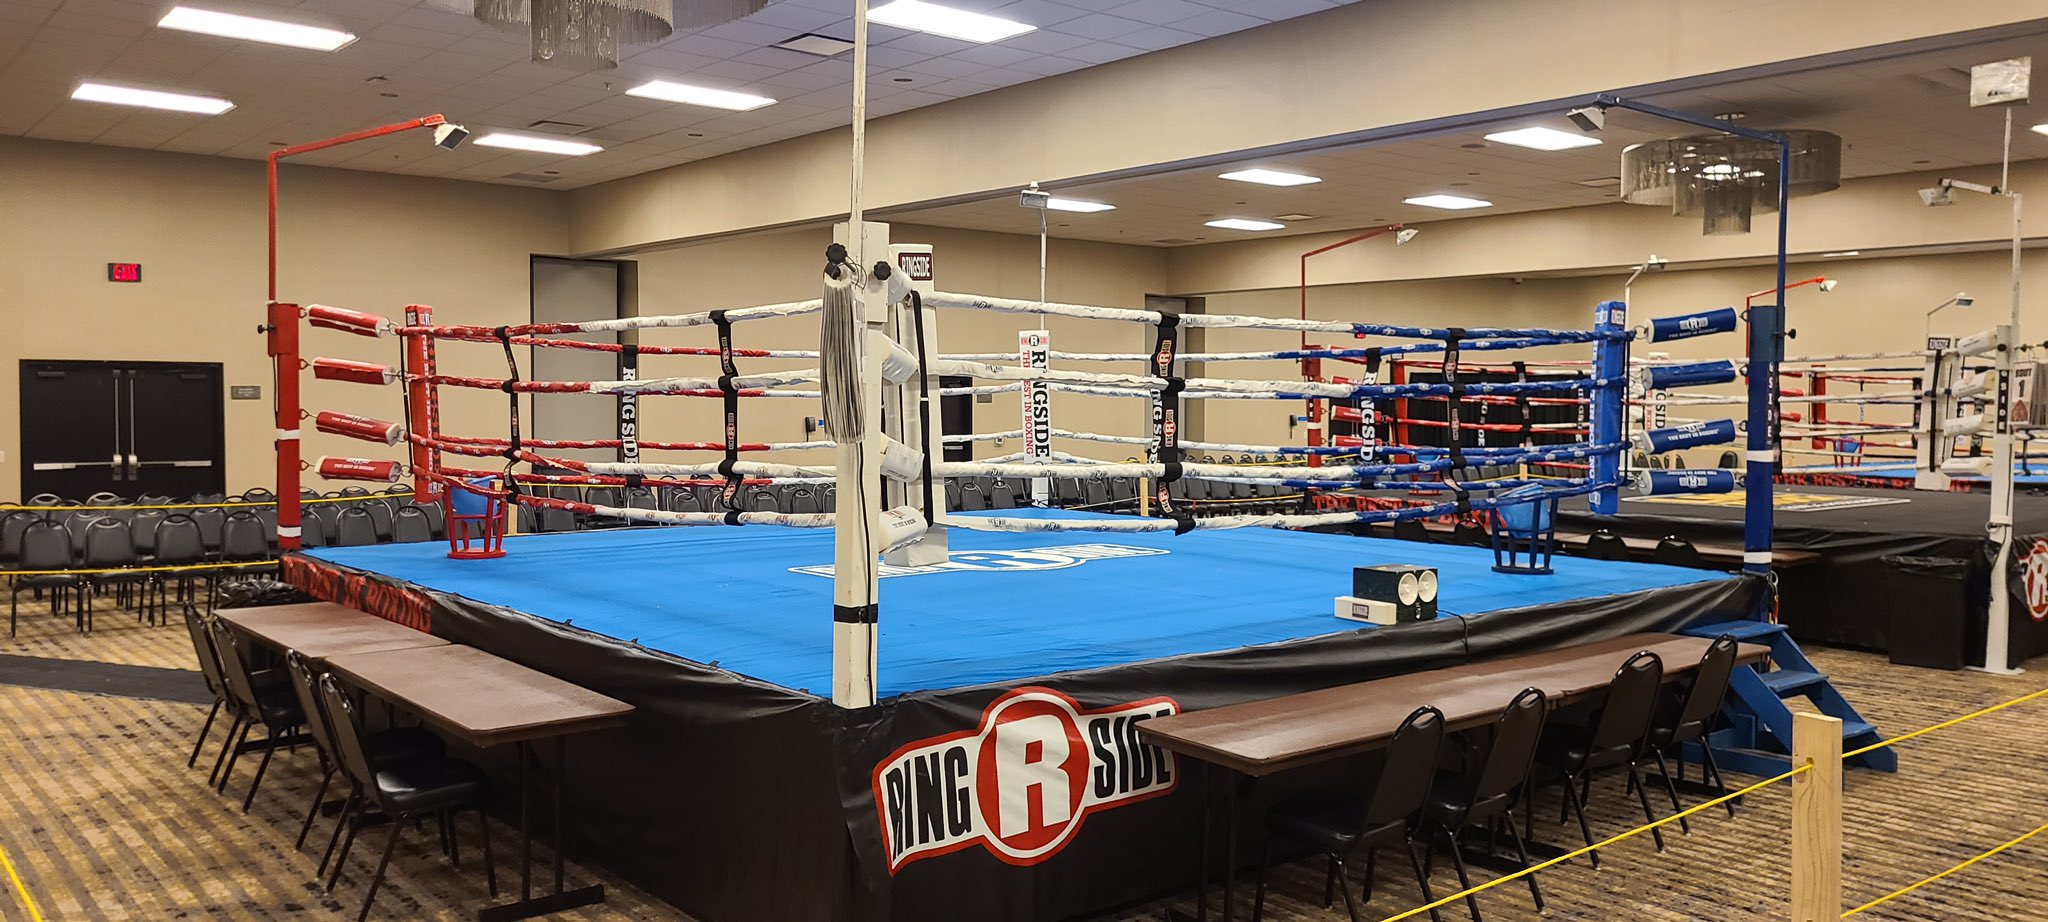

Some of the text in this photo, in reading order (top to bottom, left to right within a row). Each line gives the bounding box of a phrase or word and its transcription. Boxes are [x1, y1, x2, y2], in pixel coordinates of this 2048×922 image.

[901, 256, 931, 278] RINGSIDE
[1023, 380, 1032, 399] EST
[2018, 379, 2025, 398] 1
[1024, 401, 1032, 413] IN
[1025, 415, 1034, 455] BOXING
[367, 580, 432, 634] BOXING
[885, 745, 973, 862] RING
[995, 714, 1071, 840] R
